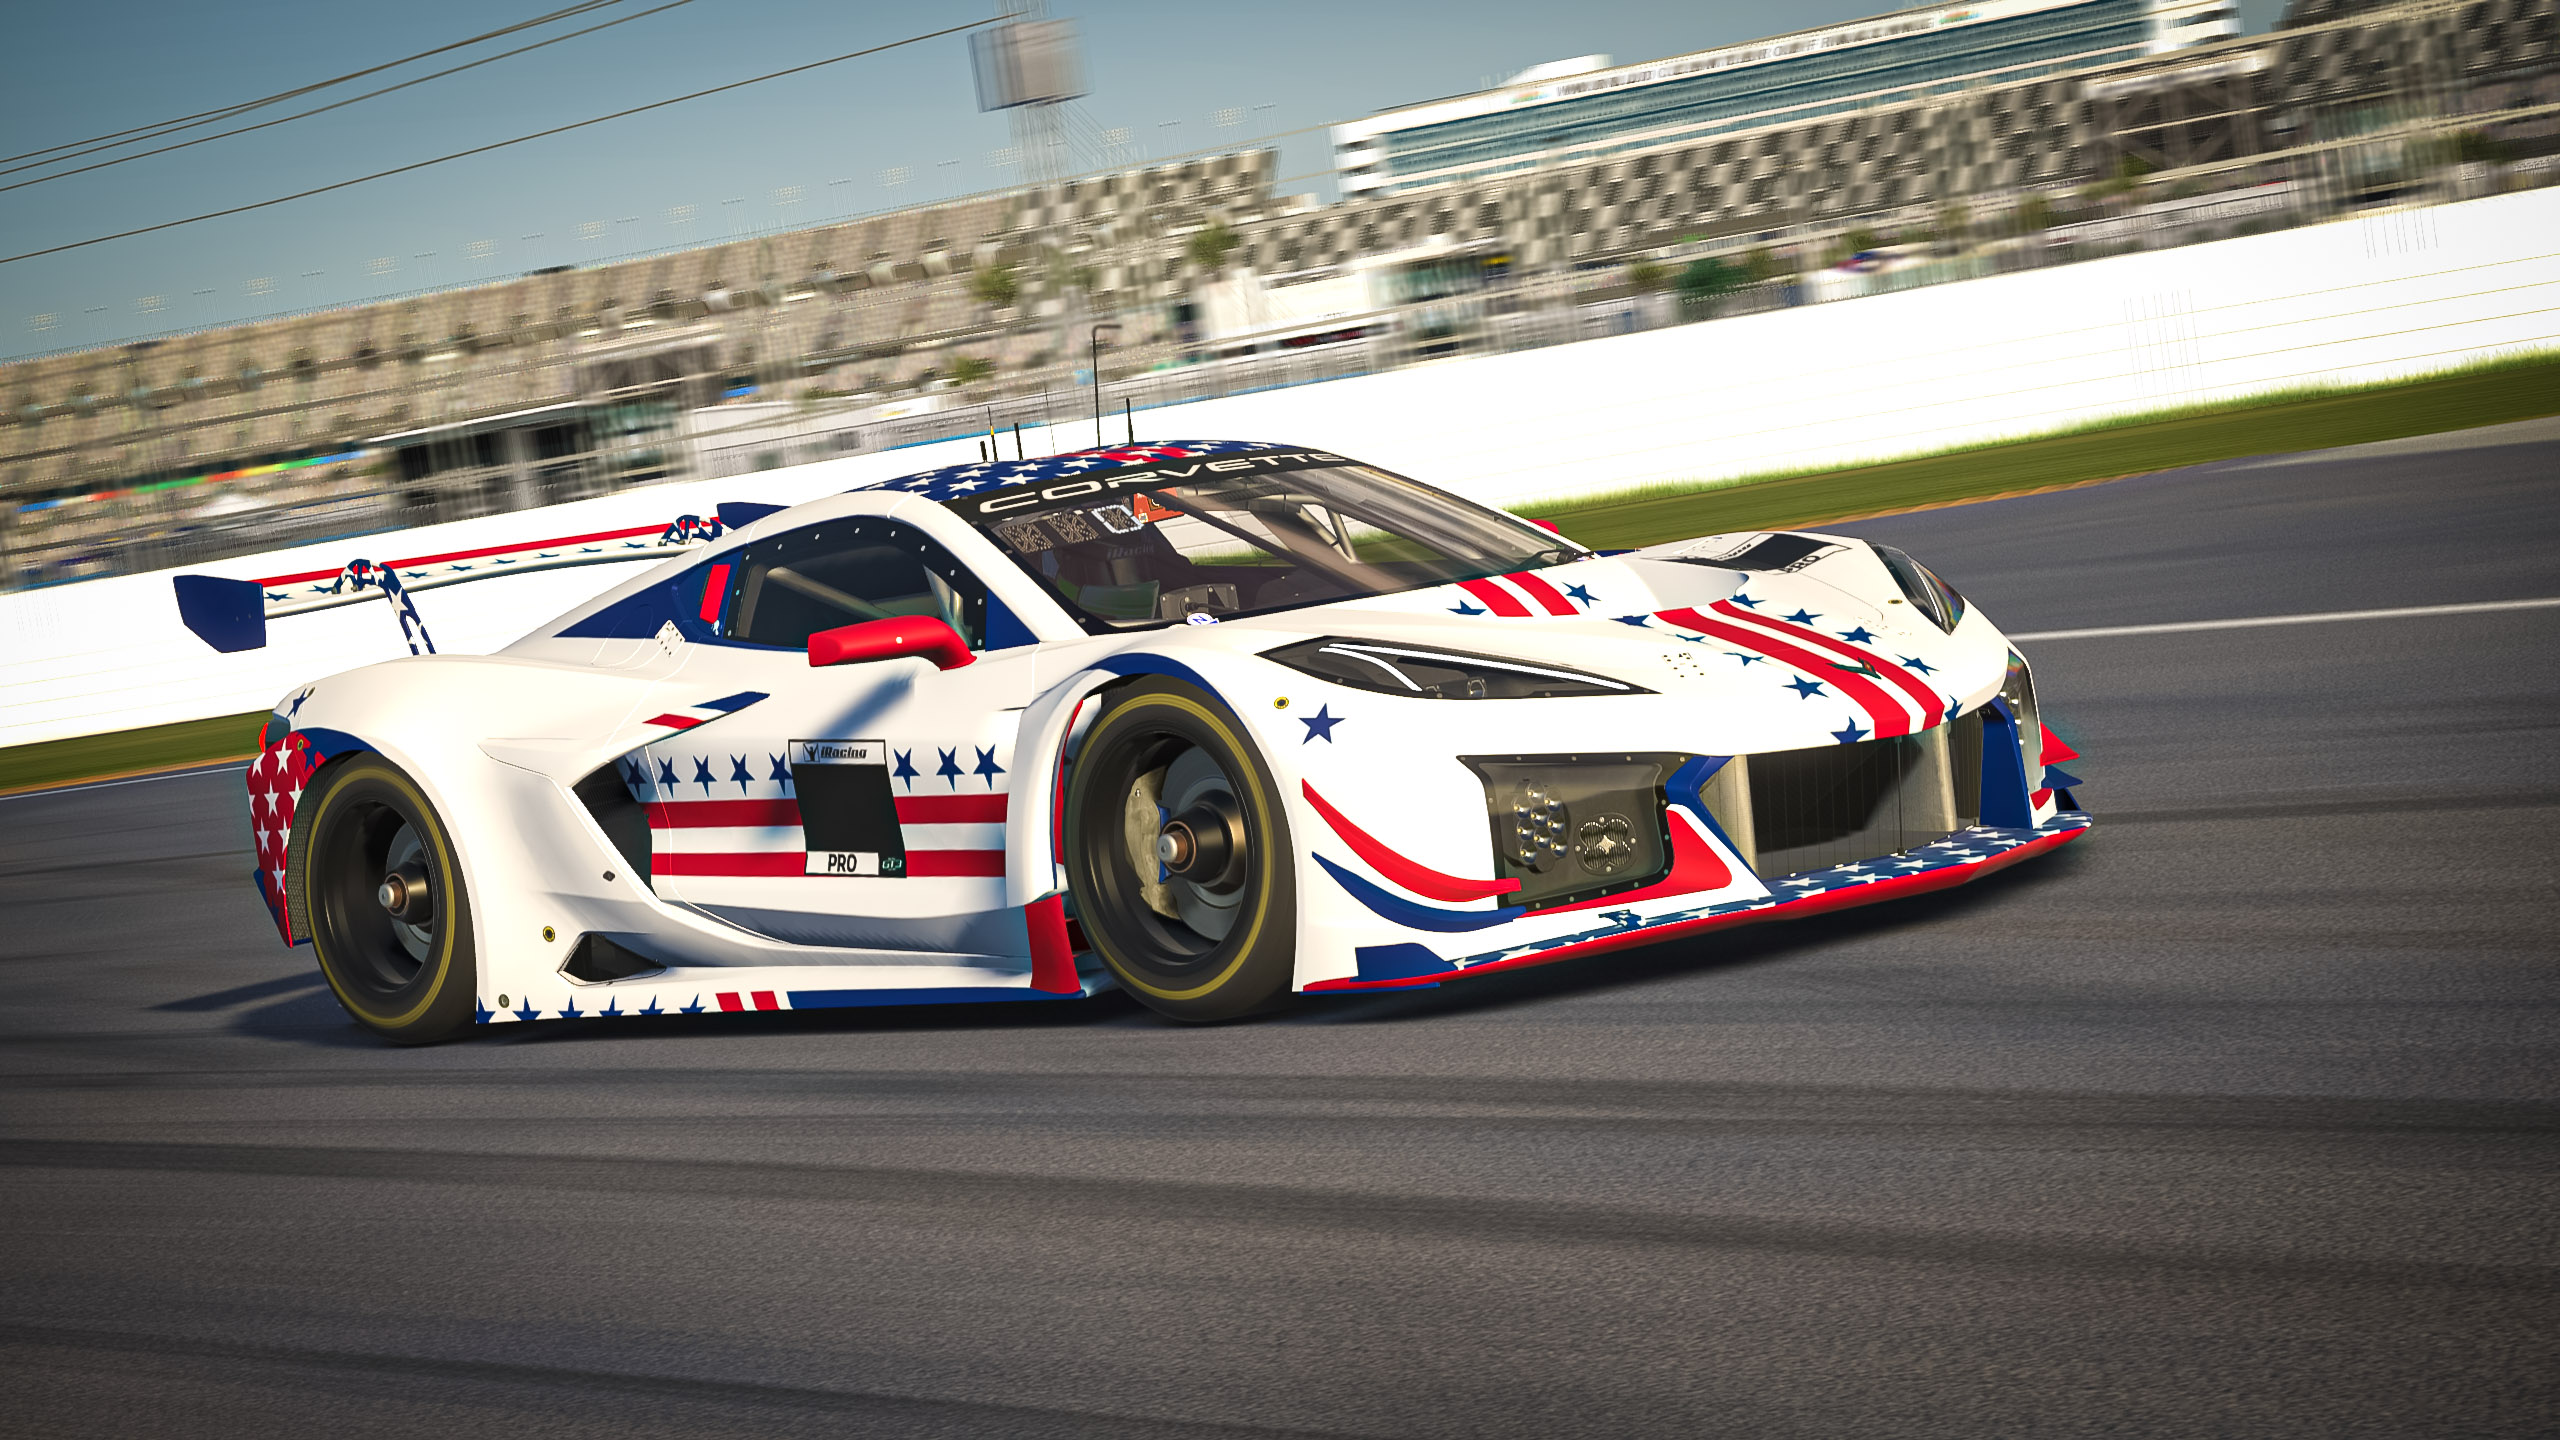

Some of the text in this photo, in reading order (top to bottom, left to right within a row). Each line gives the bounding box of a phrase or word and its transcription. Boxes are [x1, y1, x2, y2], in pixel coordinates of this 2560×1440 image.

[979, 453, 1346, 514] CORVETTE
[820, 746, 867, 759] iRacing
[828, 853, 857, 872] PRO
